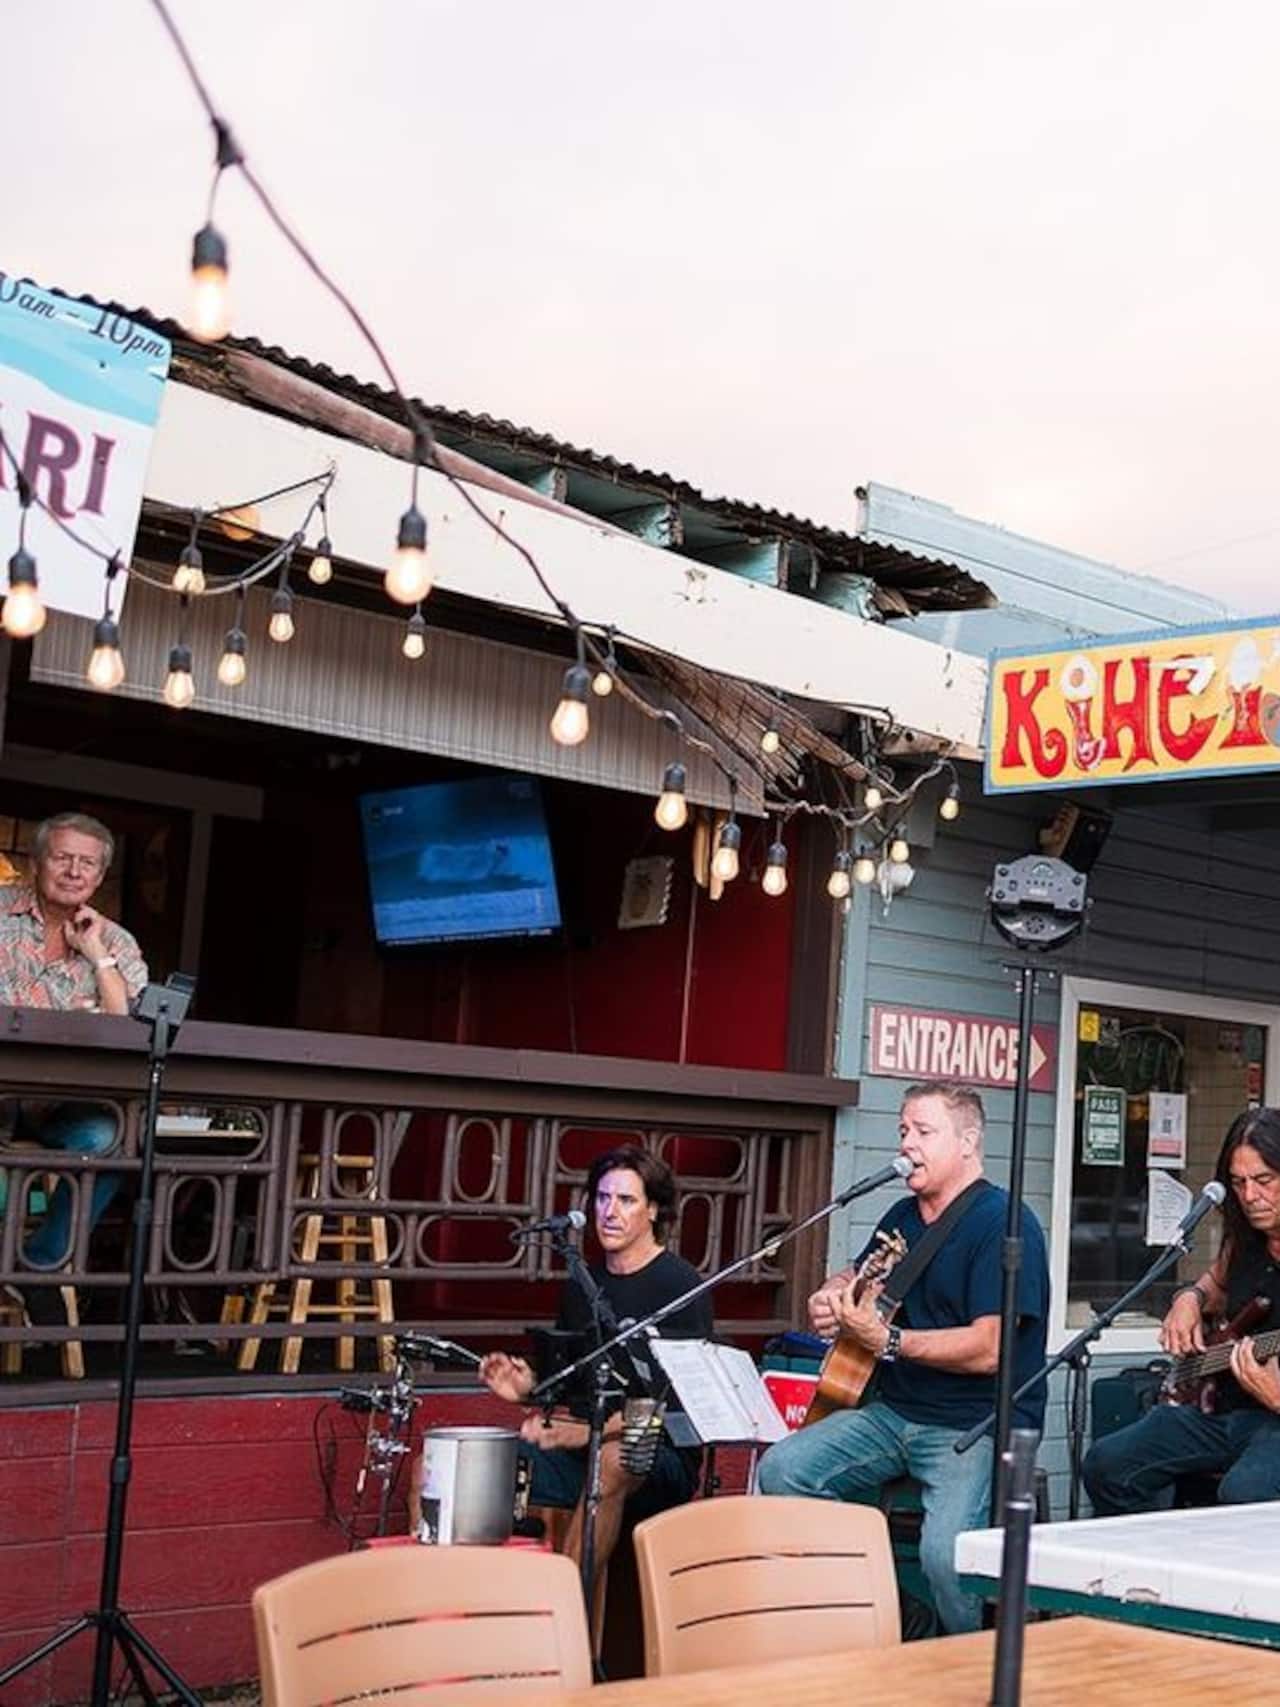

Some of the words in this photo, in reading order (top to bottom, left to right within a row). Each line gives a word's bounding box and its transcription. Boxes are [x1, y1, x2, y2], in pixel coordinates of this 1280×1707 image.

[88, 310, 167, 358] 10pm
[0, 409, 117, 518] RI
[877, 1012, 1021, 1082] ENTRANCE
[1090, 1097, 1119, 1112] PASS
